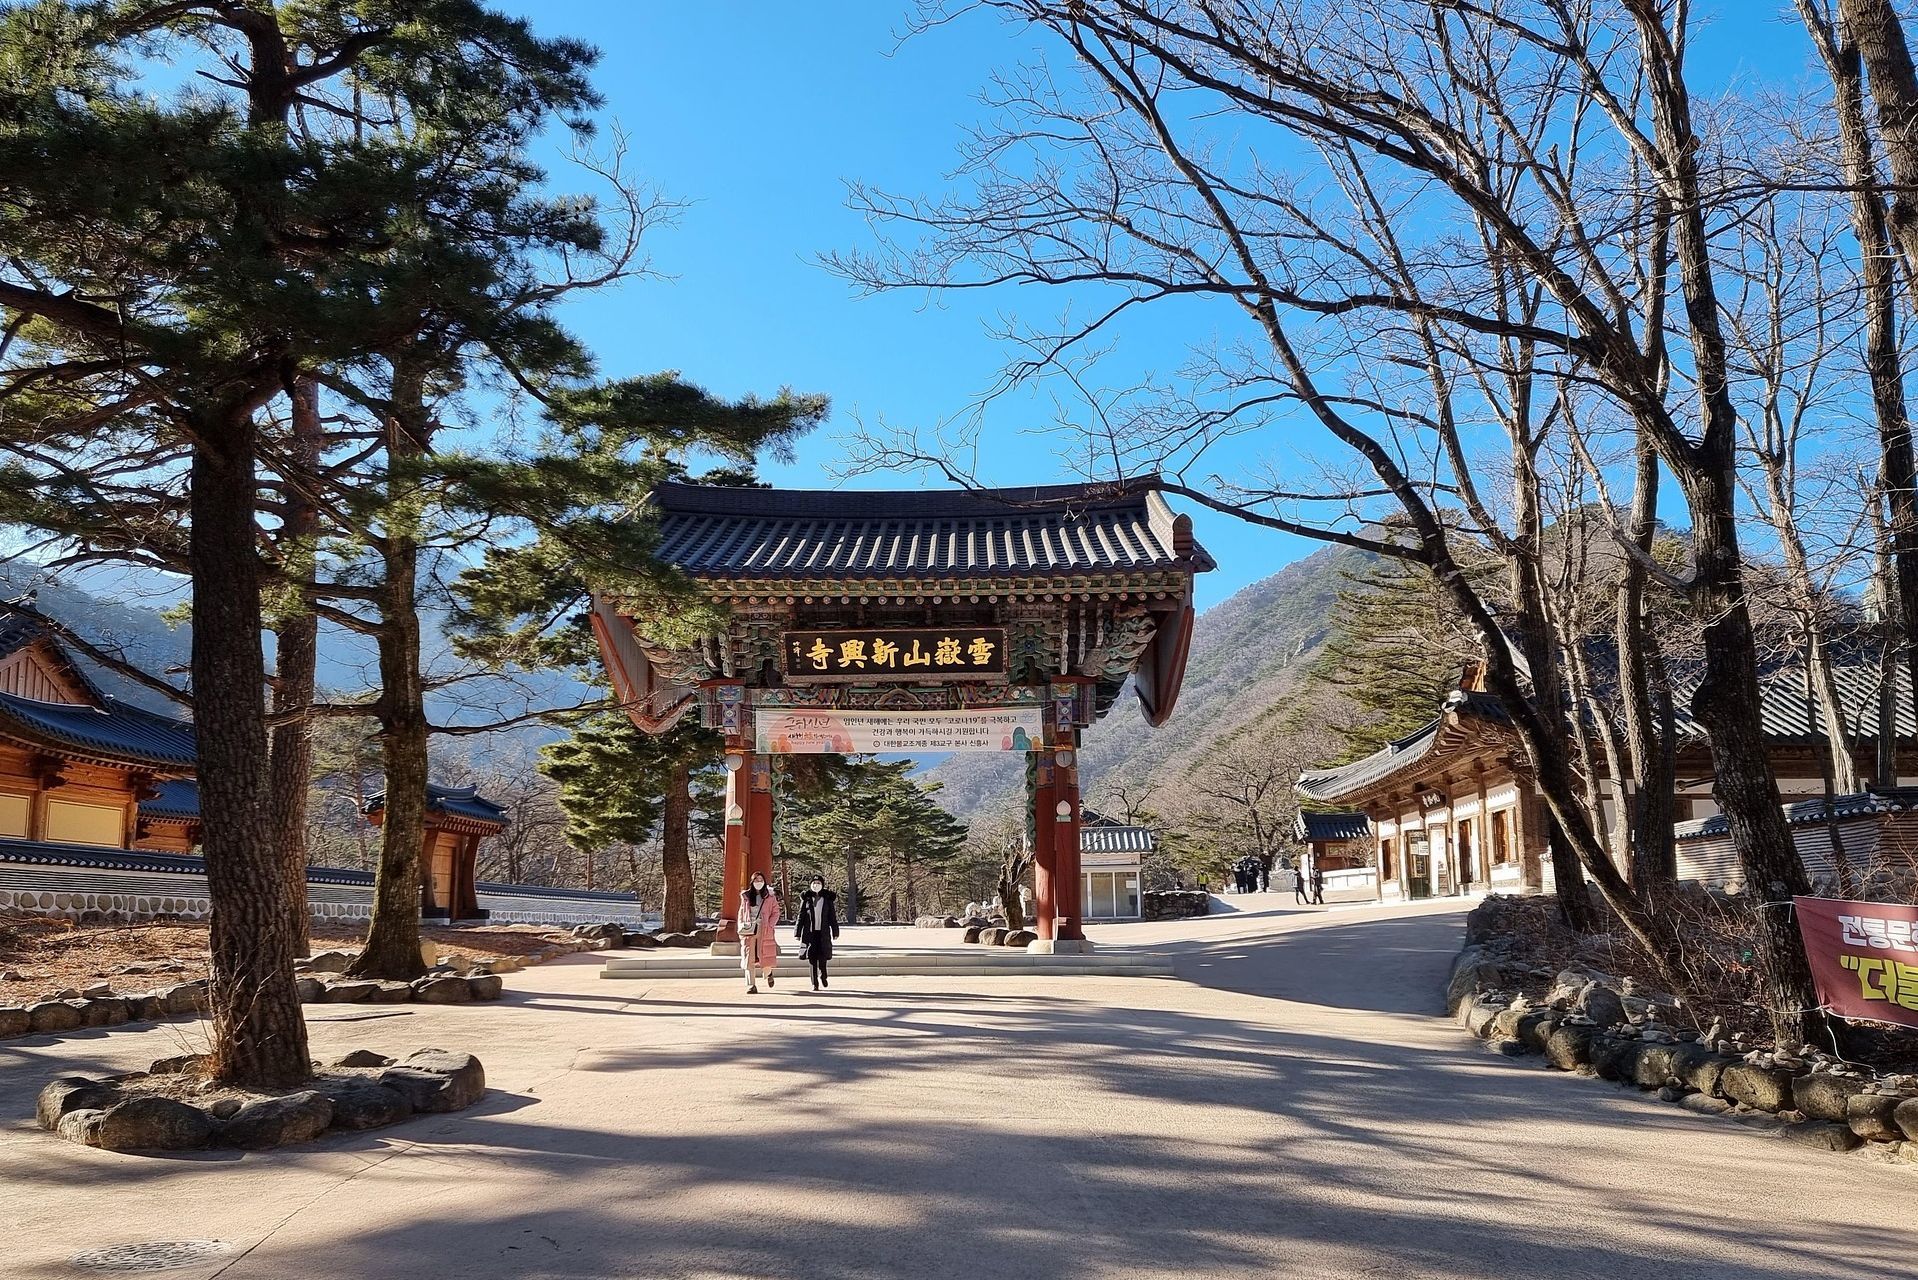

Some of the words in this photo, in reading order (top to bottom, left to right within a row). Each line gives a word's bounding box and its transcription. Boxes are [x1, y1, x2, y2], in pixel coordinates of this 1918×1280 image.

[784, 717, 832, 730] 근하신년
[843, 717, 864, 726] 임인년
[866, 717, 893, 726] 새해에는
[896, 717, 910, 726] 우리
[912, 717, 926, 725] 국민
[928, 717, 942, 725] 모두
[989, 715, 1017, 724] 극복하고
[872, 728, 893, 736] 건강과
[895, 728, 916, 736] 행복이
[918, 727, 952, 736] 가득하시길
[955, 727, 989, 735] 기원합니다
[883, 740, 928, 748] 대한불교조계종
[930, 739, 953, 747] 제3교구
[955, 739, 967, 747] 본사
[969, 739, 989, 747] 신흥사
[1838, 915, 1918, 952] 전통문
